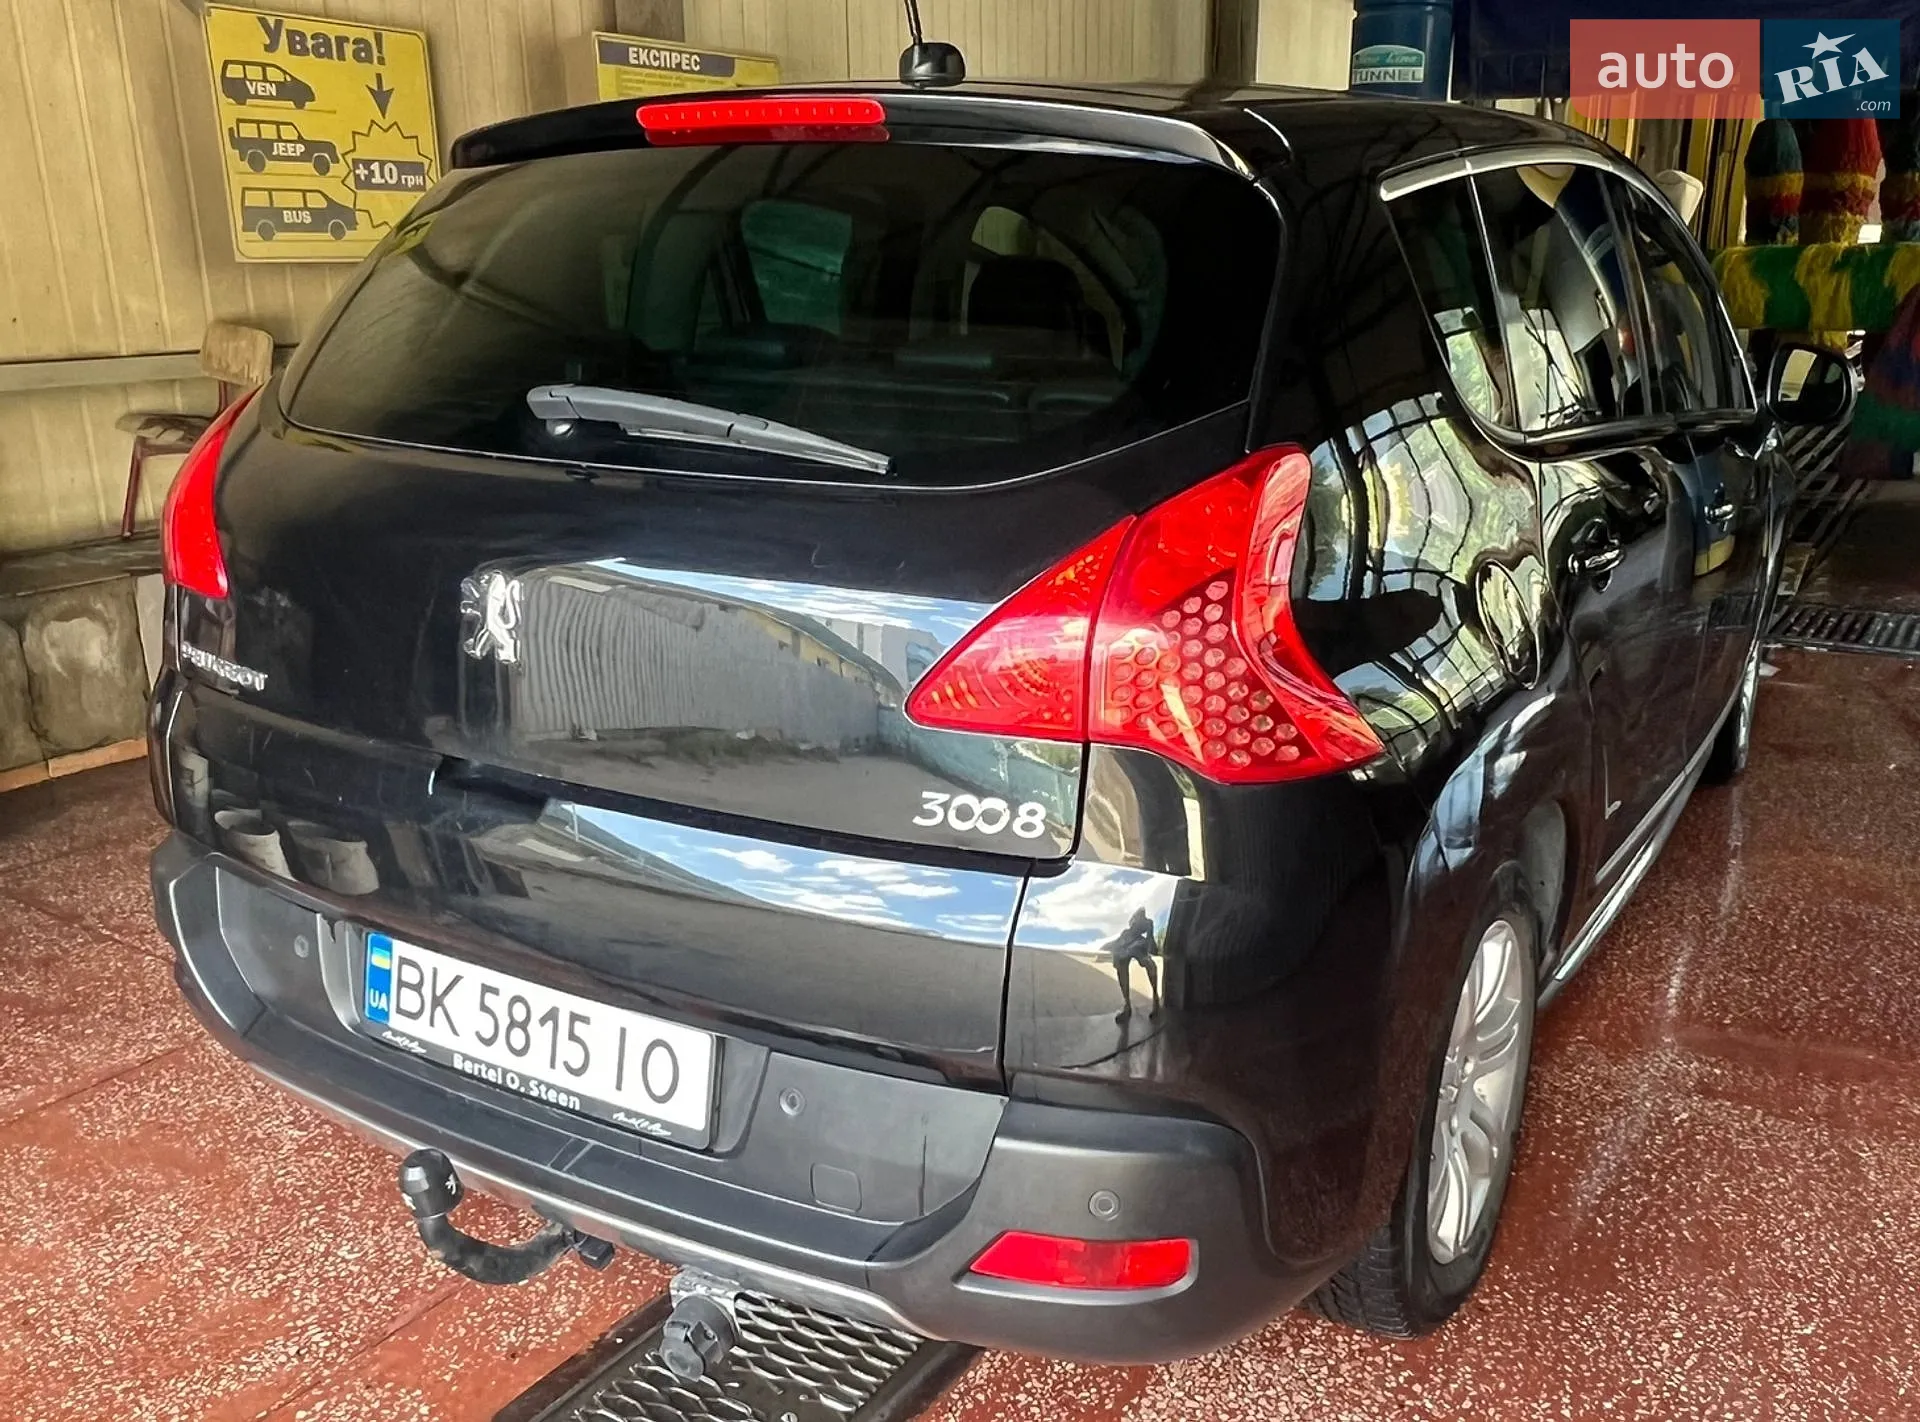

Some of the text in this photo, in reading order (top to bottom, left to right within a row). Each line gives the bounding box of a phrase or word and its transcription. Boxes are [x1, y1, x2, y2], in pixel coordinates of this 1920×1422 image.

[256, 16, 386, 66] Увага!
[628, 47, 701, 72] ЕКСПРЕС
[1353, 69, 1423, 82] TUNNEL
[245, 80, 277, 97] VEN
[271, 142, 306, 157] JEEP
[355, 161, 425, 188] +10 грн
[282, 210, 312, 224] BUS
[912, 791, 1046, 839] 3008
[370, 994, 389, 1012] UA
[395, 955, 680, 1104] BK 5815 IO
[452, 1053, 503, 1084] Bertel
[529, 1079, 581, 1111] Steen
